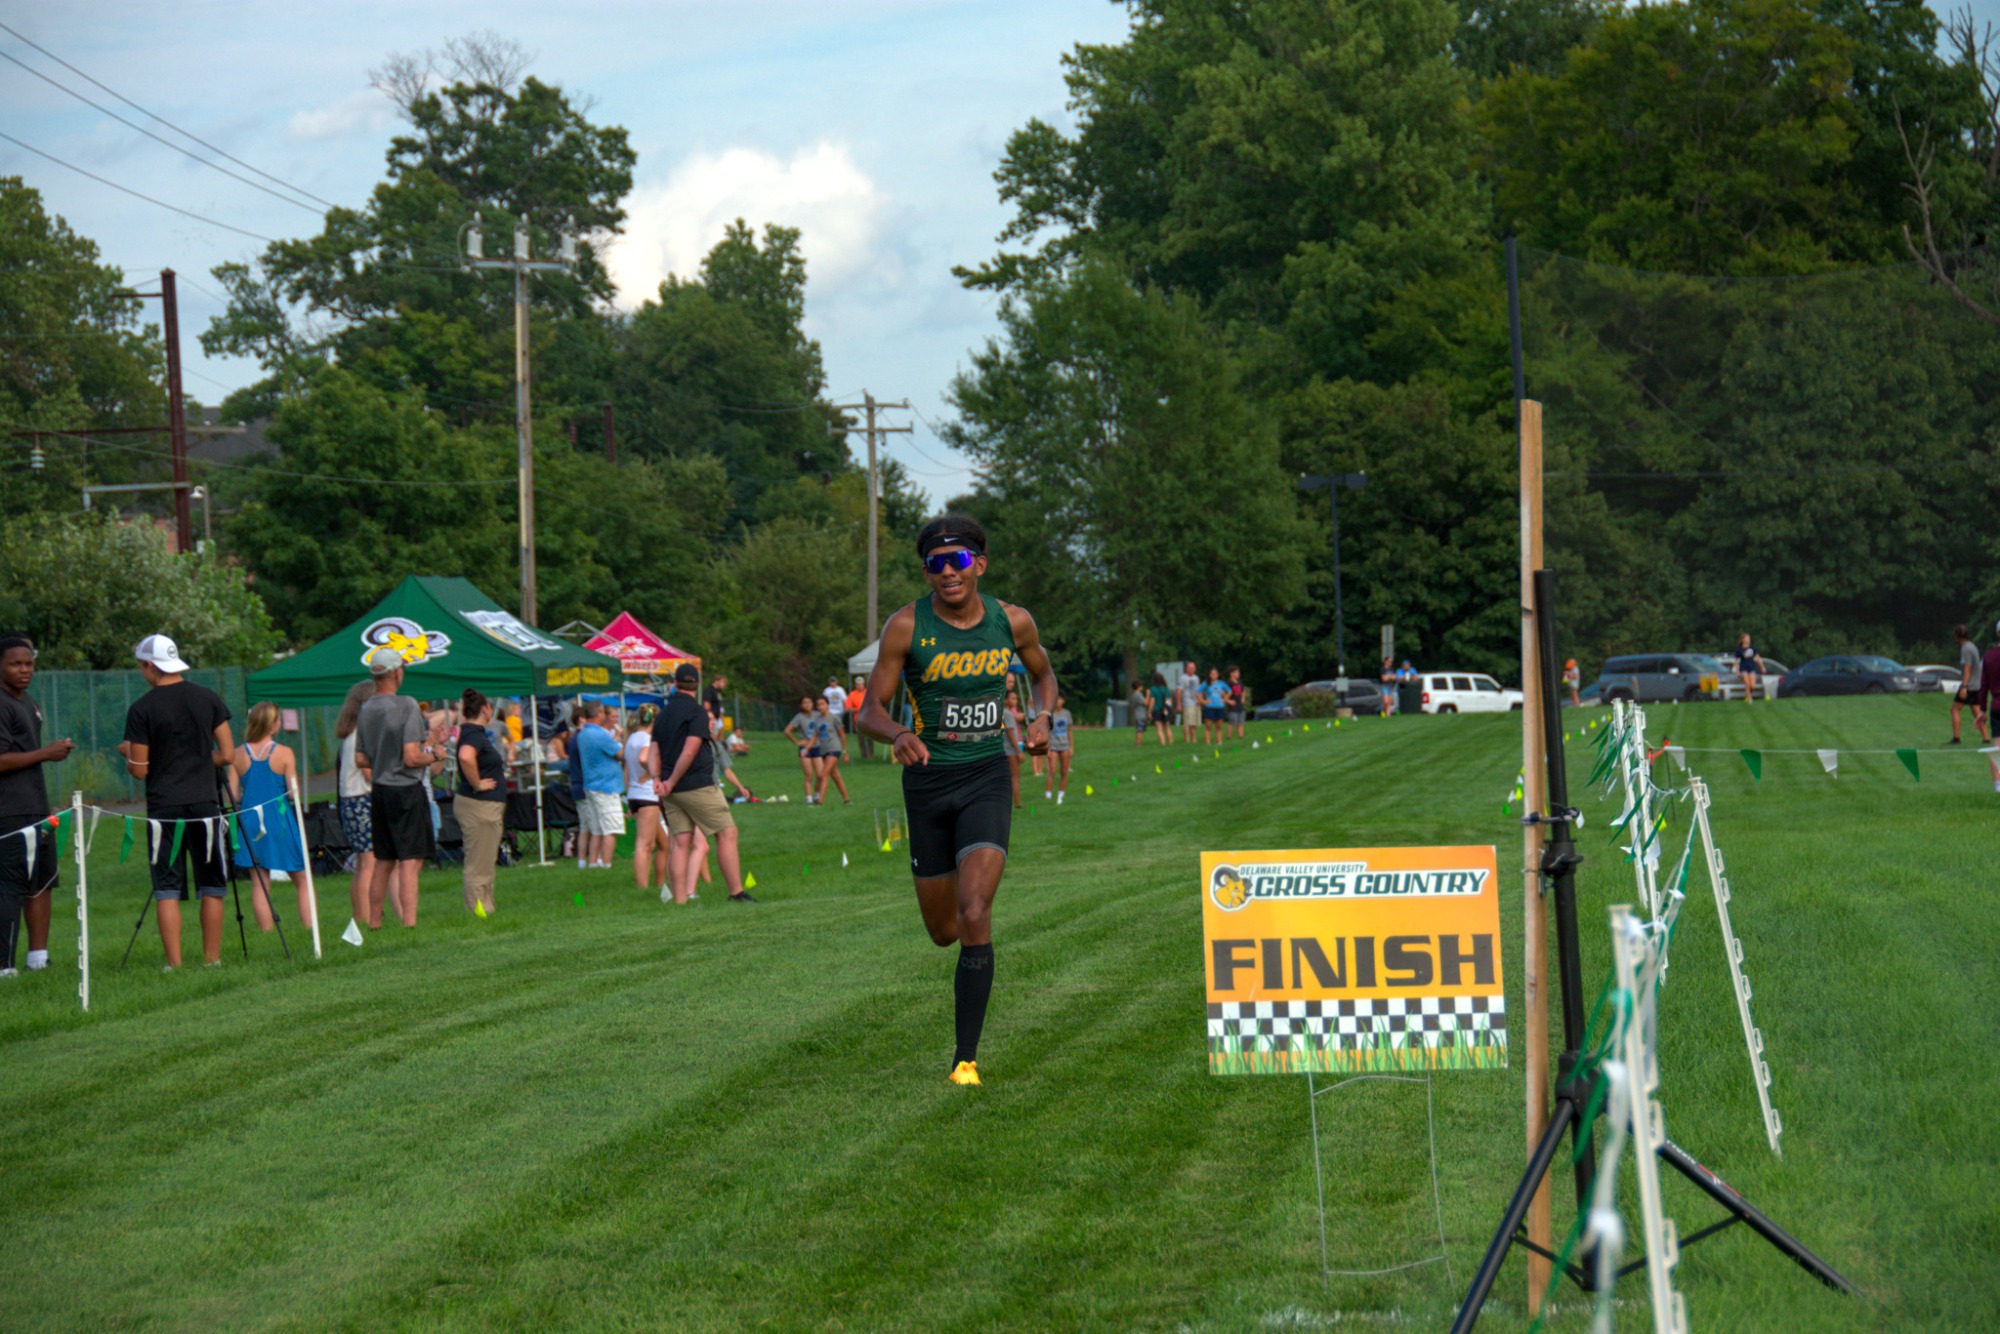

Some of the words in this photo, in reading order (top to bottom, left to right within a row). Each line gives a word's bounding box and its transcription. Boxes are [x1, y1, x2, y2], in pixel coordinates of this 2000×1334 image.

[922, 648, 1011, 682] AGGIES
[945, 702, 997, 728] 5350
[1240, 866, 1282, 876] DELAWARE
[1285, 865, 1314, 875] VALLEY
[1316, 863, 1365, 874] UNIVERSITY
[1255, 875, 1345, 896] CROSS
[1354, 872, 1485, 894] COUNTRY
[1212, 934, 1495, 990] FINISH
